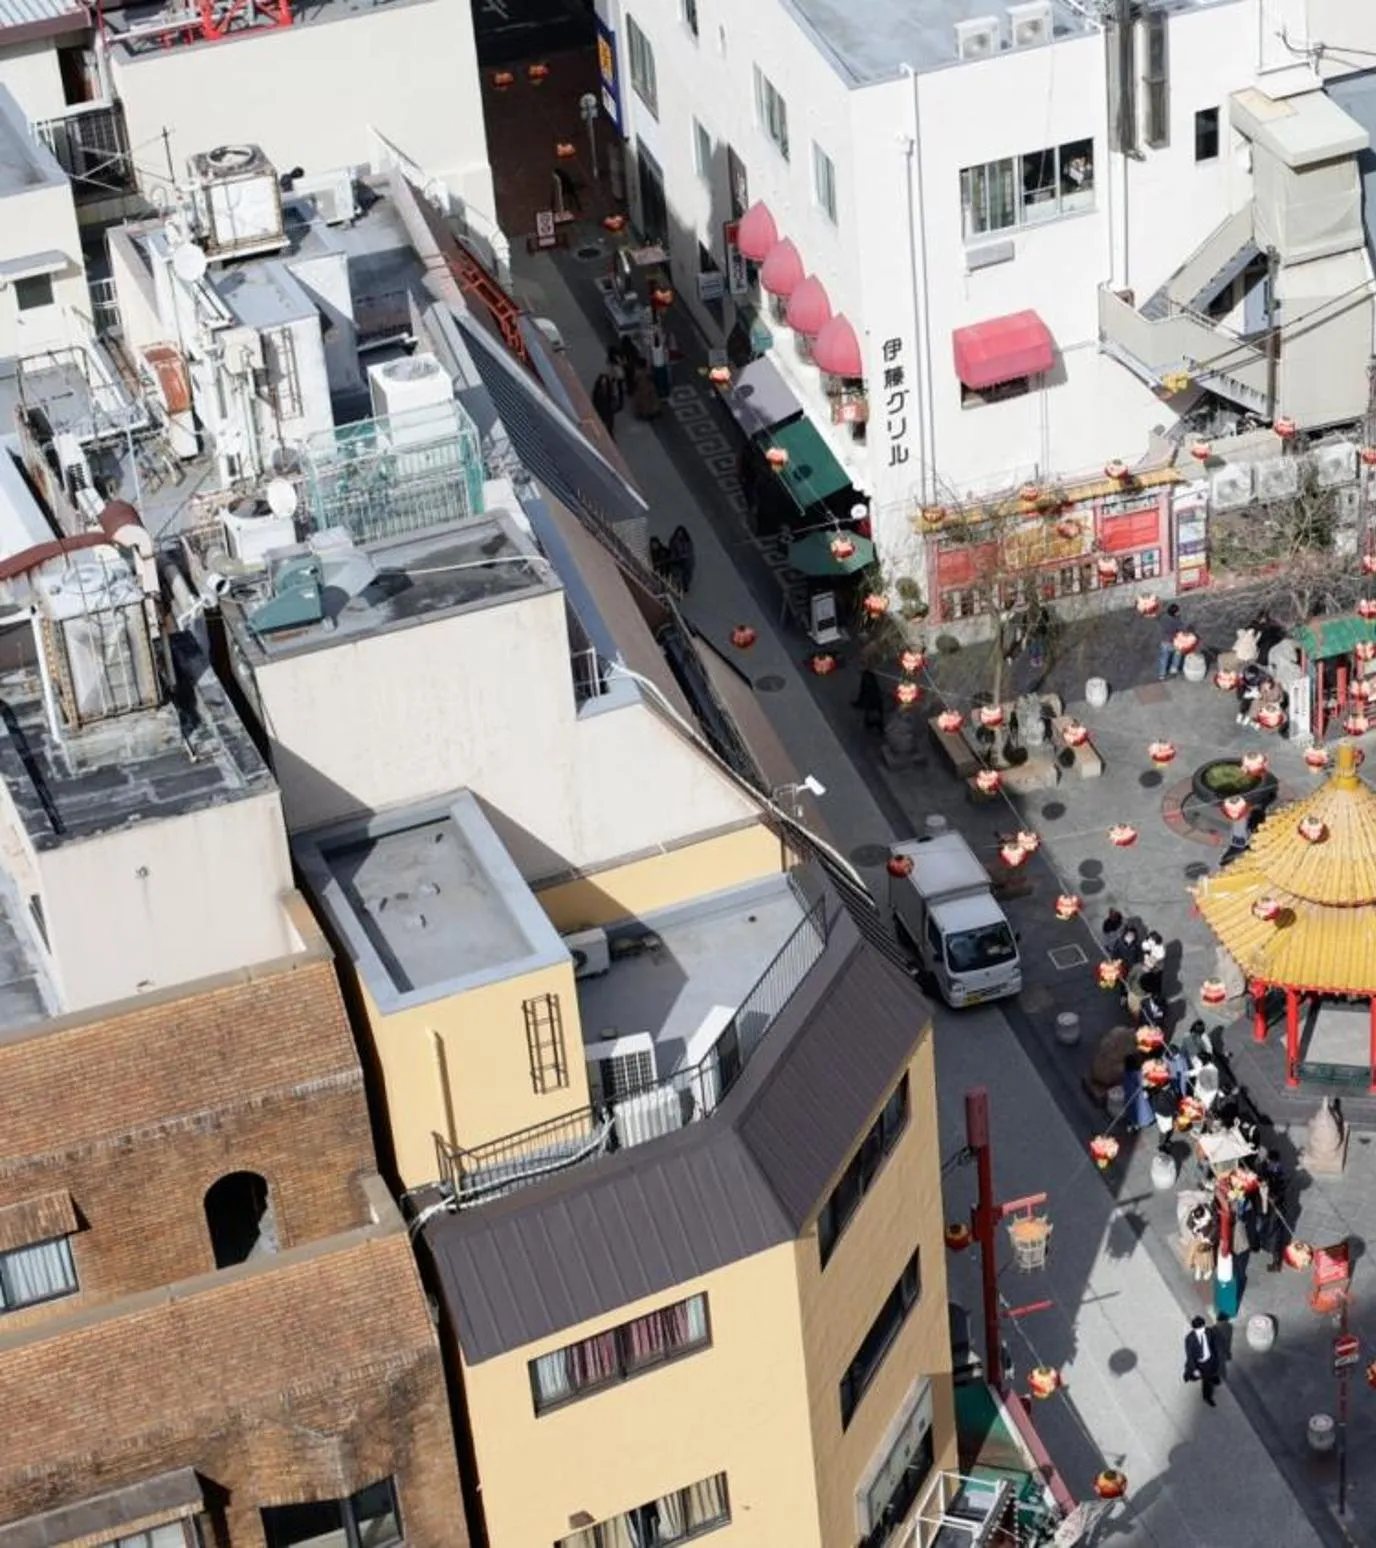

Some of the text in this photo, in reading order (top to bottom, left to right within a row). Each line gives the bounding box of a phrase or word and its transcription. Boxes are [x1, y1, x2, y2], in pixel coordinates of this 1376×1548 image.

[882, 337, 910, 467] 伊藤グリル
